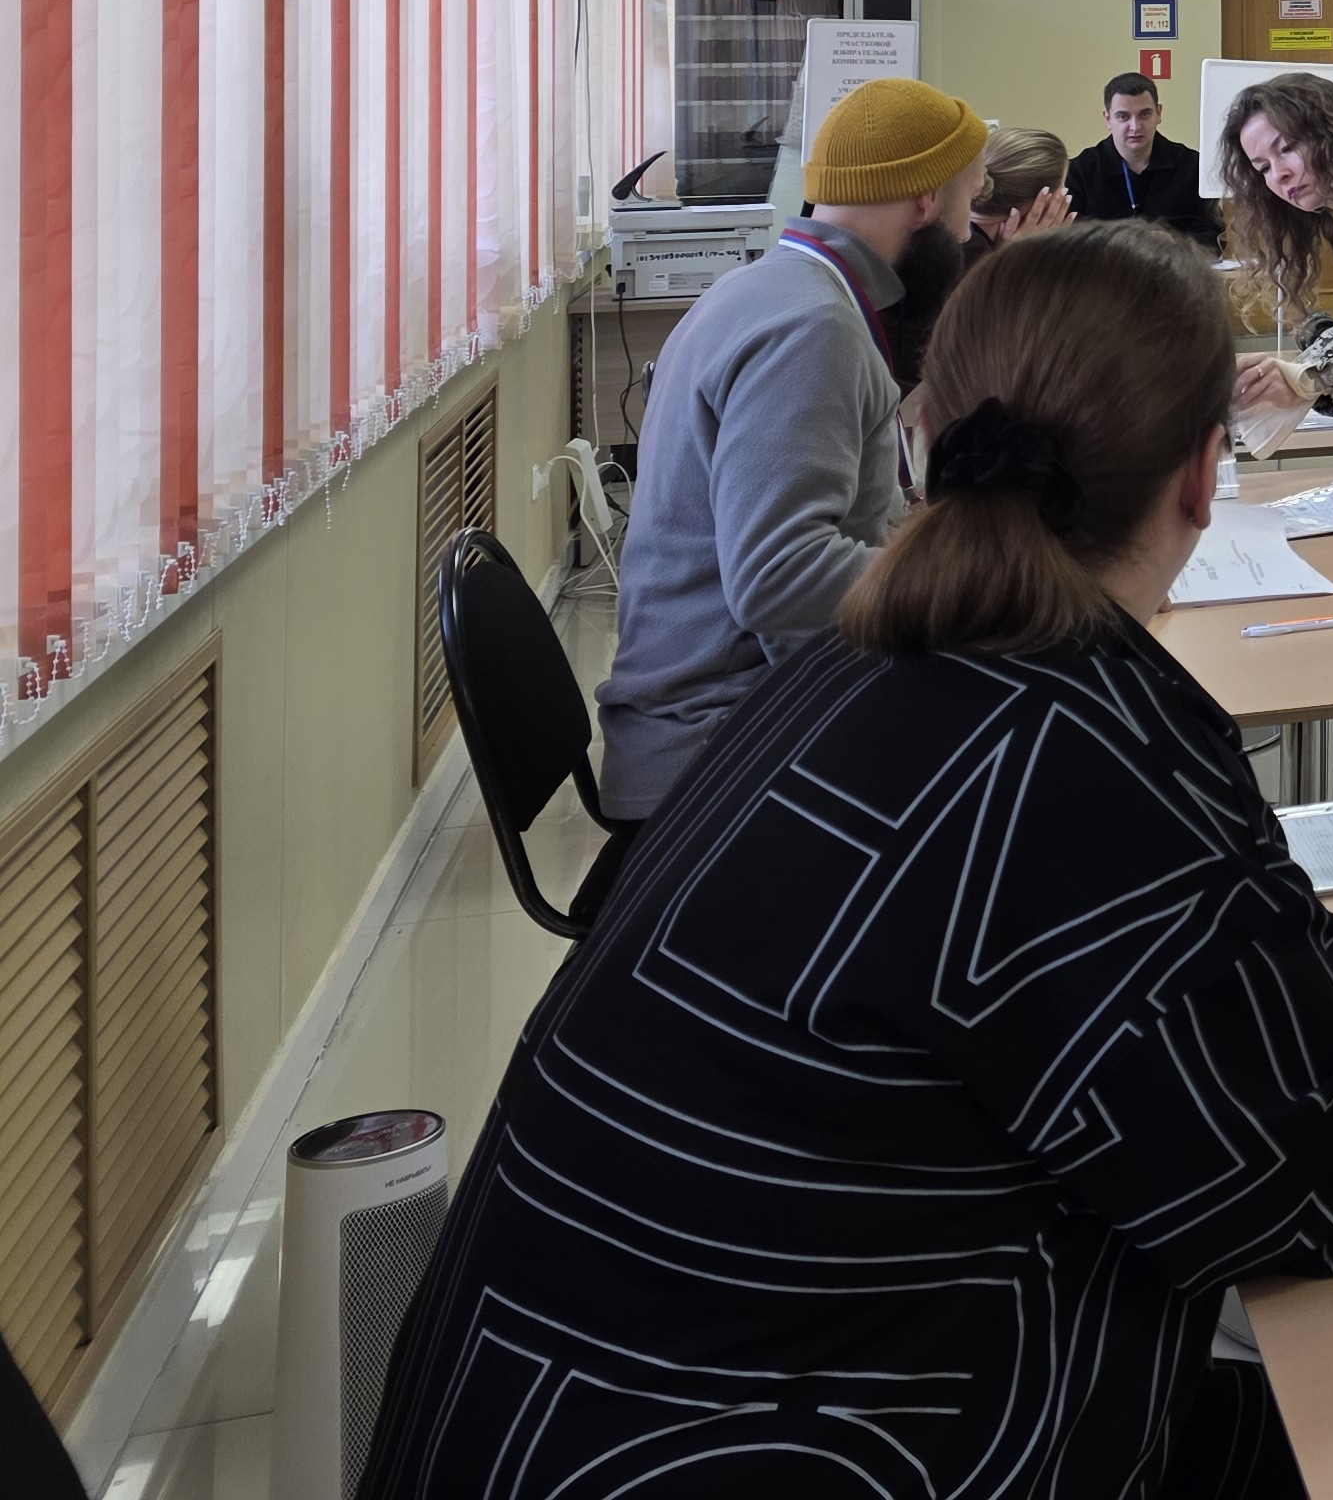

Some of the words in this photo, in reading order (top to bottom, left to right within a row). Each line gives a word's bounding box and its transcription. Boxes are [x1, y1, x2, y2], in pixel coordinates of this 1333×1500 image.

[1157, 20, 1169, 29] 112
[836, 31, 896, 39] ПРЕДСЕДАТЕЛЬ
[839, 40, 891, 48] УЧАСТКОВОЙ
[832, 49, 898, 57] ИЗБИРАТЕЛЬНОЙ
